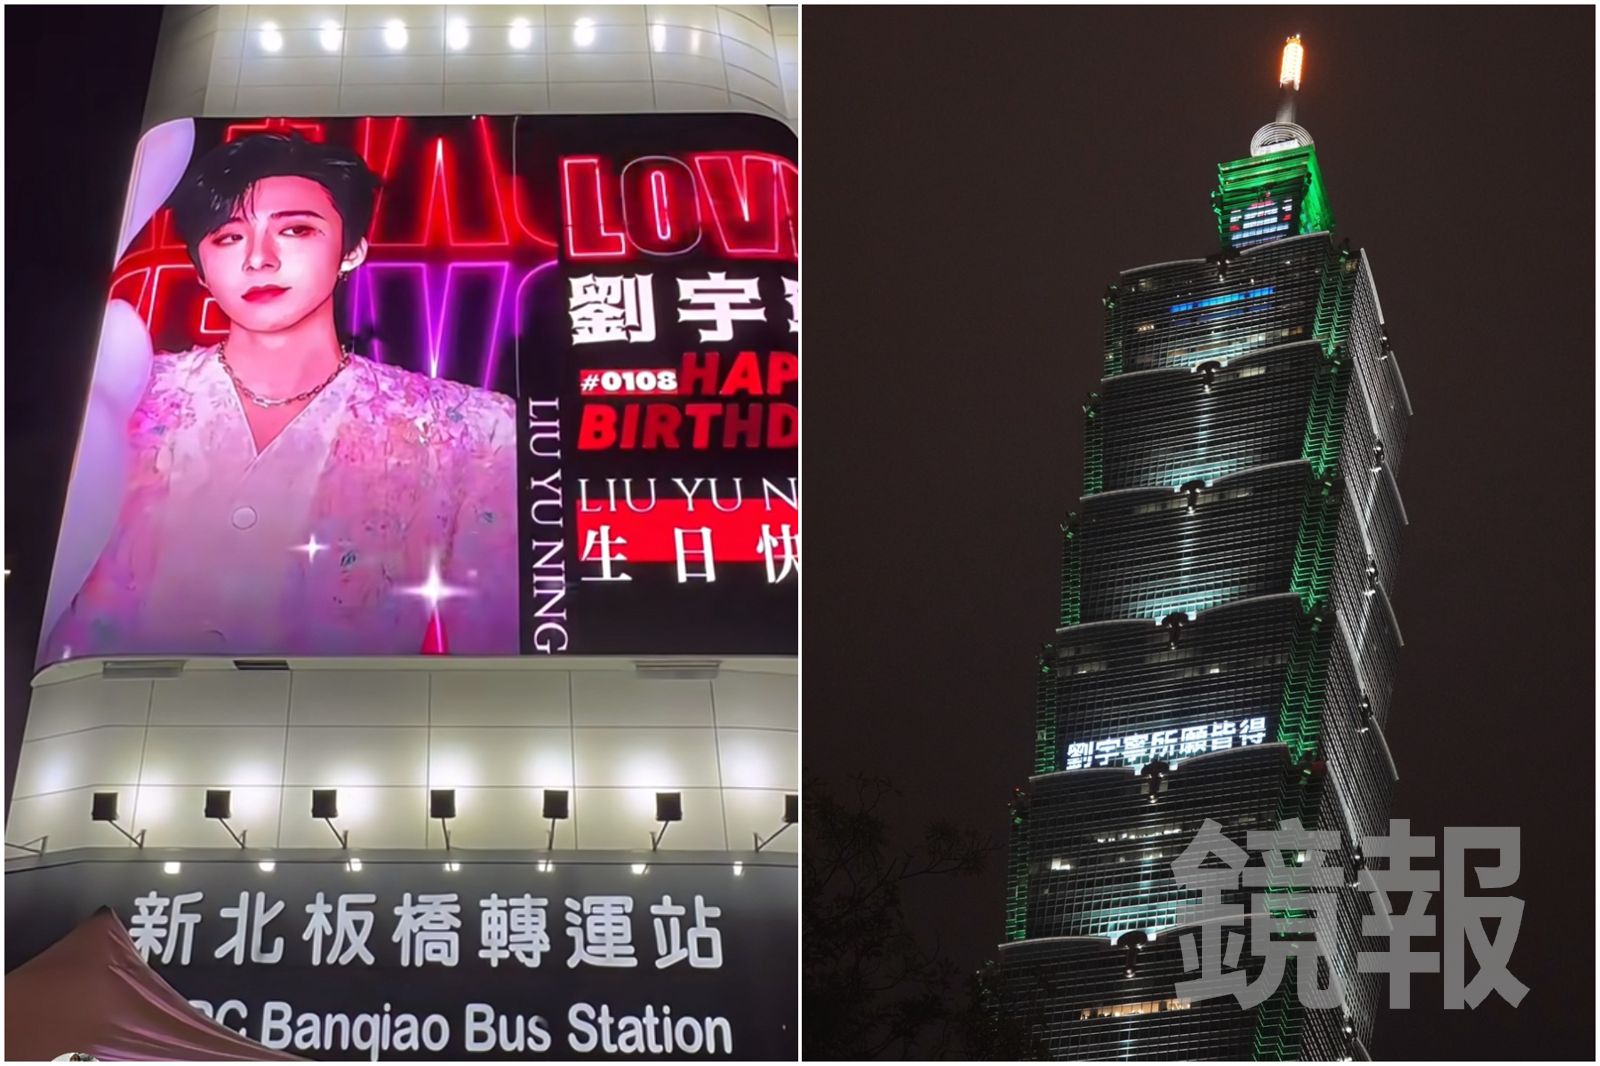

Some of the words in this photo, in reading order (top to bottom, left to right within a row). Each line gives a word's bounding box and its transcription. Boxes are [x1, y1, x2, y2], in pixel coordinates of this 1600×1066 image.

[568, 271, 797, 346] 劉宇
[580, 371, 678, 391] #0108
[528, 397, 562, 459] LIU
[530, 468, 563, 528] YU
[578, 478, 657, 512] LIU
[671, 477, 743, 512] YU
[532, 539, 569, 654] NING
[129, 890, 723, 969] 新北板橋轉運站
[261, 1001, 450, 1062] Banqiao
[465, 1003, 551, 1051] Bus
[568, 1002, 733, 1054] Station
